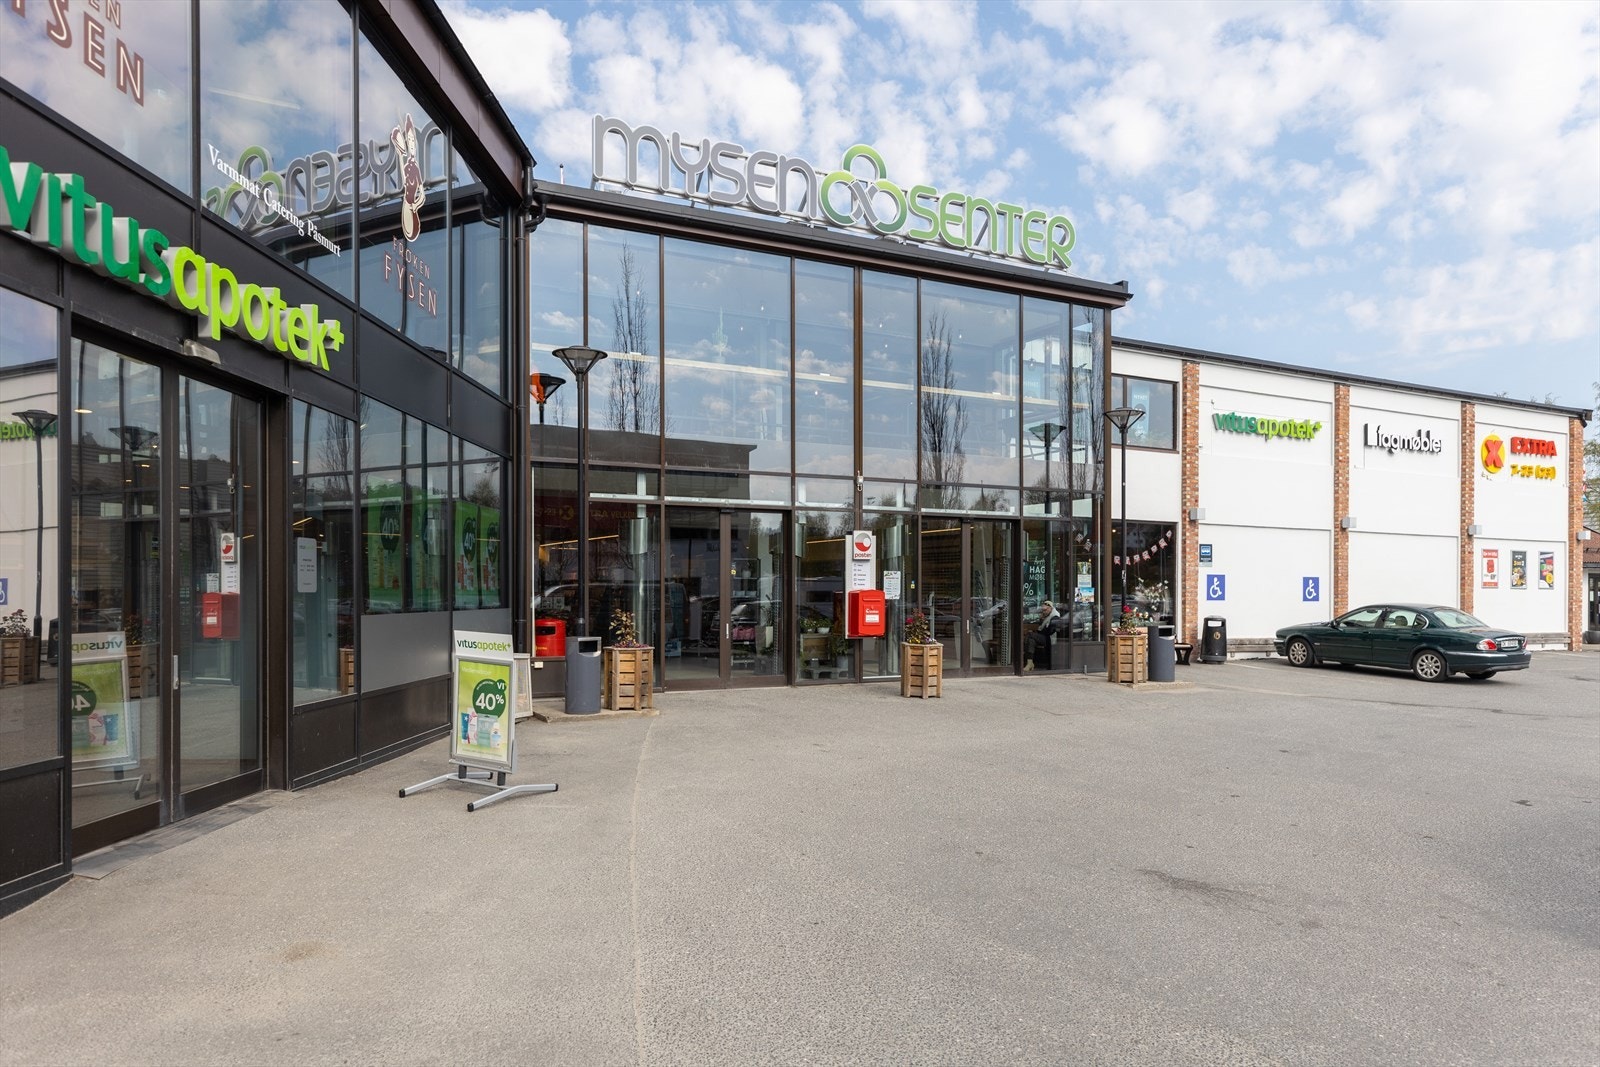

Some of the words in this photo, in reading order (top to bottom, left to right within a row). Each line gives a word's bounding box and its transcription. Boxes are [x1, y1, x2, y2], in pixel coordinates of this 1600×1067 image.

[207, 143, 260, 198] Varmmat
[263, 187, 305, 237] Catering
[302, 219, 341, 257] Påsmurt
[908, 184, 1076, 268] SENTER
[384, 249, 437, 318] FYSEN
[1511, 436, 1557, 457] EXTRA
[475, 692, 505, 711] 40%
